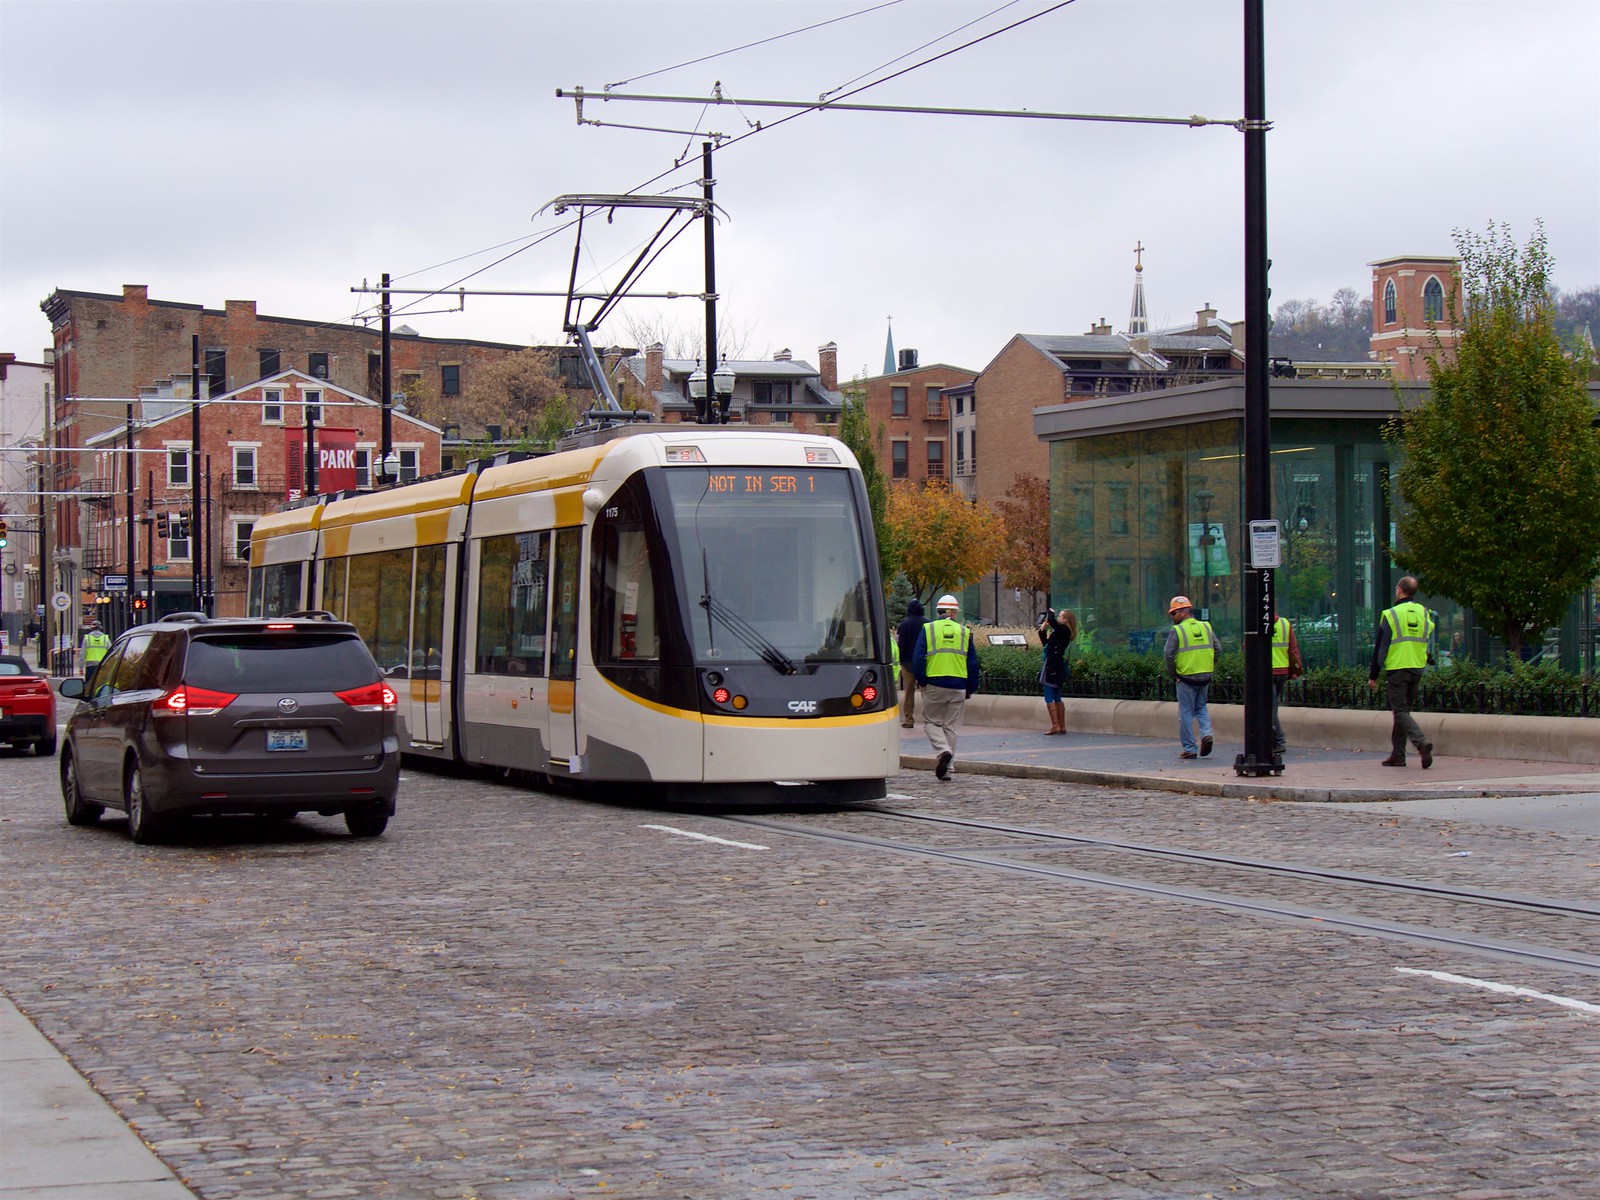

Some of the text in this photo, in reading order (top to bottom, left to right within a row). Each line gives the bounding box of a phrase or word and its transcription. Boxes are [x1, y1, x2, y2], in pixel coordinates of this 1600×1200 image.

[320, 449, 355, 469] PARK
[289, 440, 301, 501] WASHINGTON PA
[709, 475, 815, 493] NOT IN SER 1
[606, 507, 619, 518] 1175
[787, 700, 817, 713] CAF
